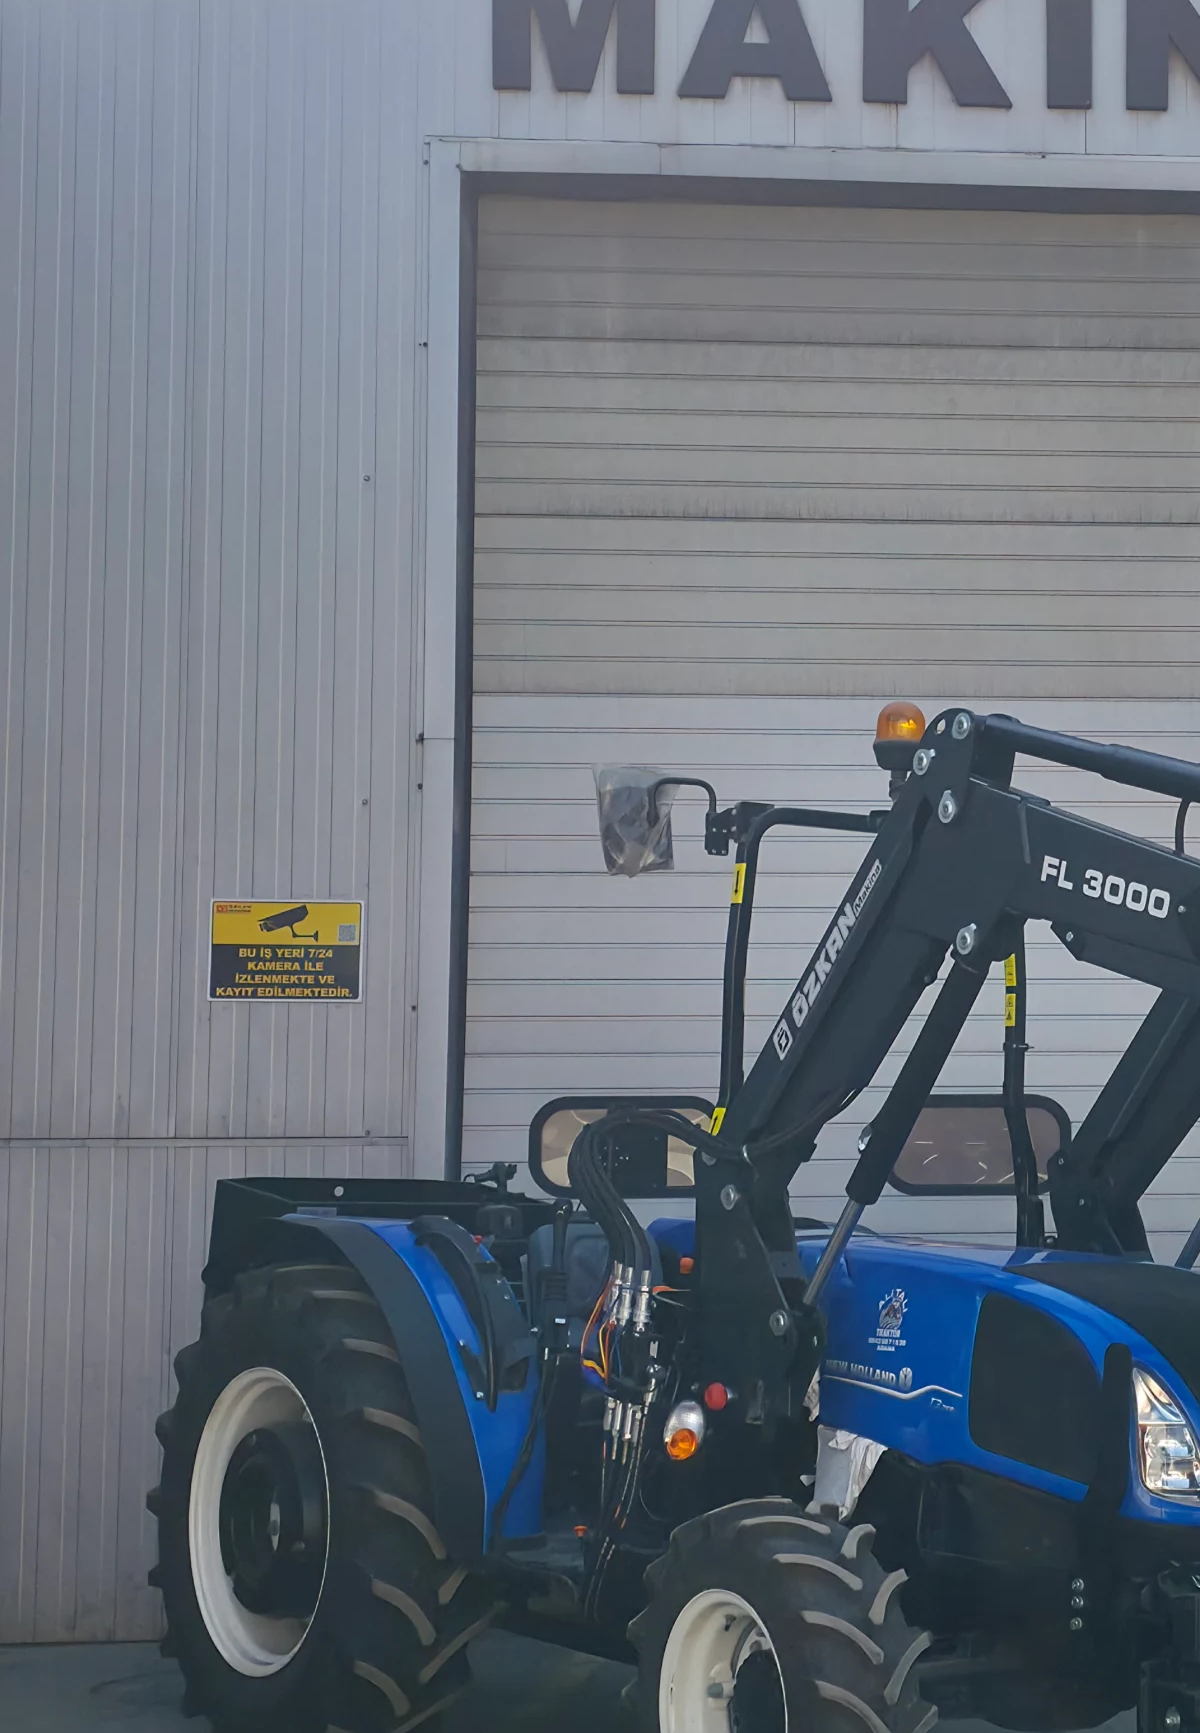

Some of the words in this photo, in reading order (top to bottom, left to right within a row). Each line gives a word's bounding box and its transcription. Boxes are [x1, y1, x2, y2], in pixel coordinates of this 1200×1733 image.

[1040, 854, 1074, 890] FL
[1082, 868, 1171, 919] 3000
[792, 902, 857, 1028] ÖZKAN
[853, 863, 881, 914] Makina
[238, 948, 256, 958] BU
[260, 947, 272, 959] İŞ
[275, 947, 305, 958] YERİ
[308, 948, 333, 958] 7/24
[247, 961, 300, 971] KAMERA
[304, 960, 324, 971] İLE
[235, 973, 315, 984] İZLENMEKTE
[318, 975, 335, 984] VE
[216, 987, 254, 997] KAYIT
[257, 986, 352, 997] EDİLMEKTEDİR.
[826, 1359, 848, 1373] NEW
[850, 1362, 897, 1386] HOLLAND
